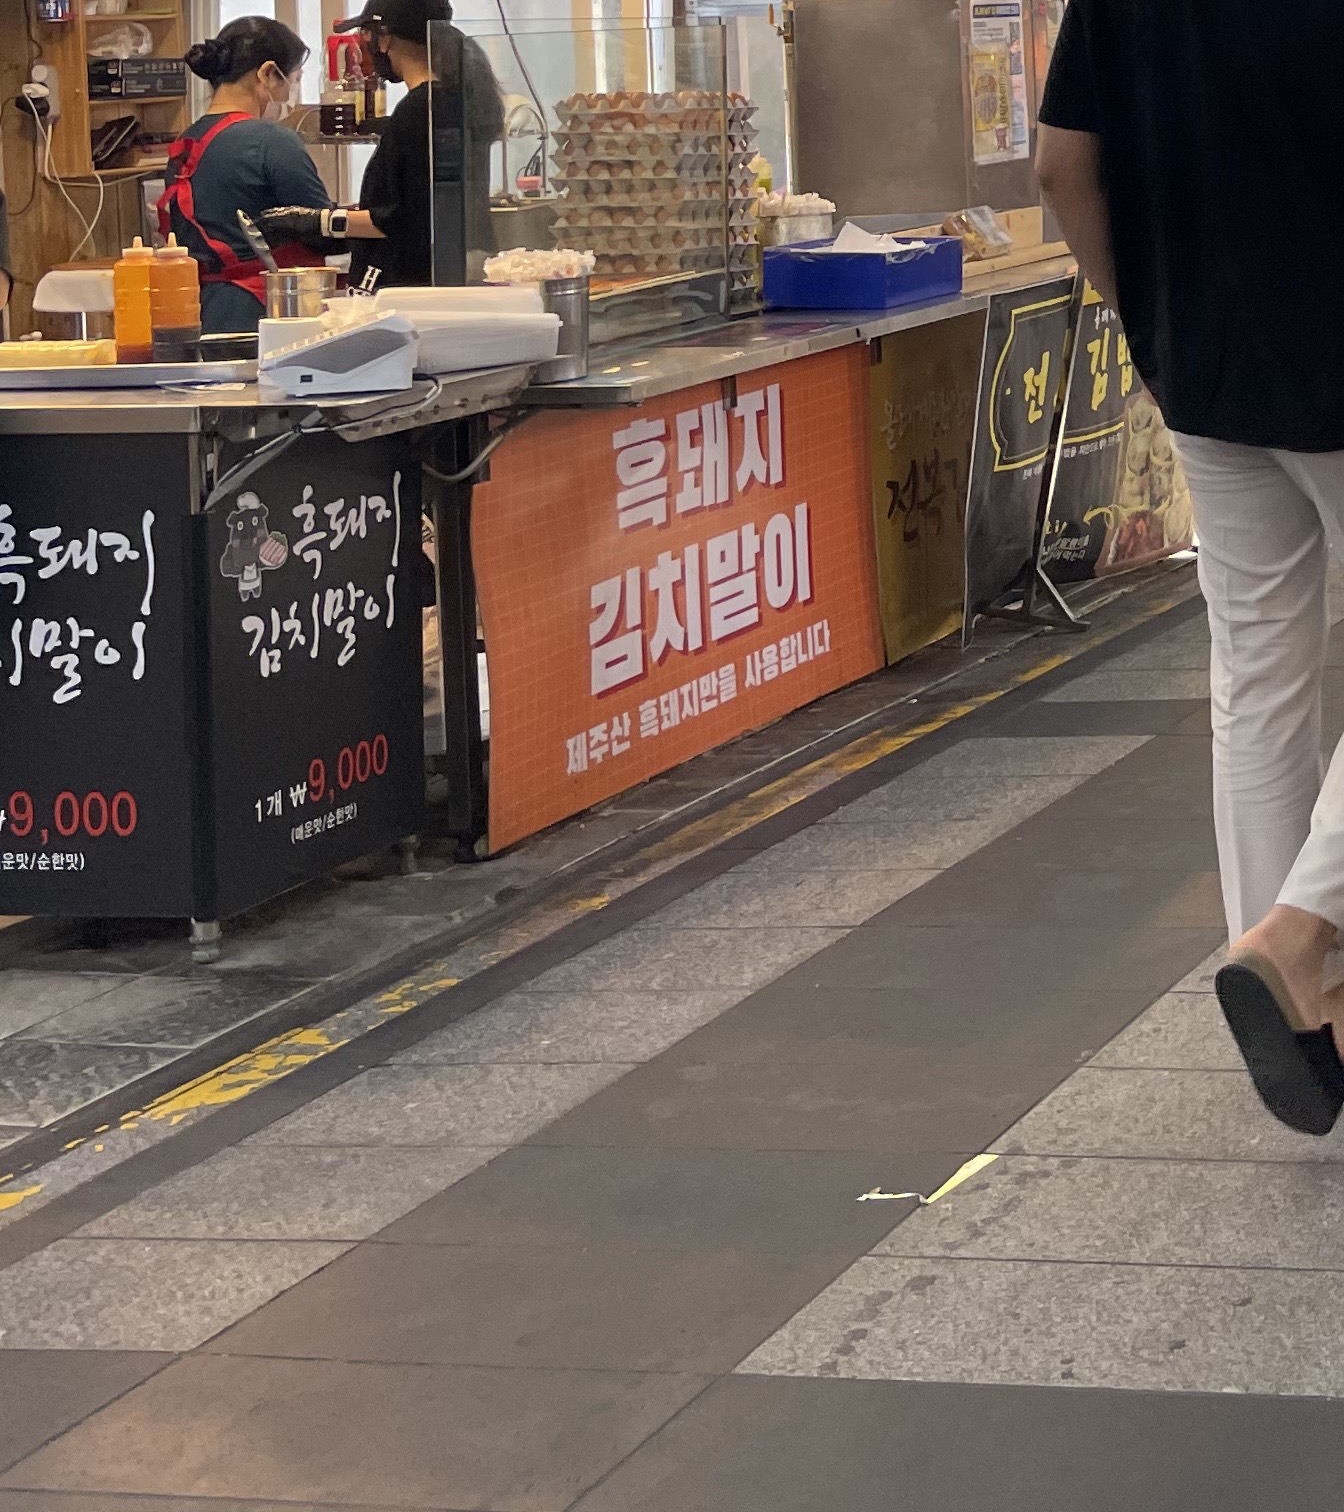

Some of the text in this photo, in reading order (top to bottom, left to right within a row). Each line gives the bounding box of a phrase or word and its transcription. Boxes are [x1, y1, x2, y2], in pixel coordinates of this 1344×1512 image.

[610, 383, 787, 533] 흑돼지
[291, 470, 402, 580] 흑돼지
[240, 574, 397, 679] 김치말이
[588, 501, 814, 699] 김치말이
[565, 617, 832, 778] 제주산 흑돼지만을 사용합니다
[254, 788, 284, 823] 1개
